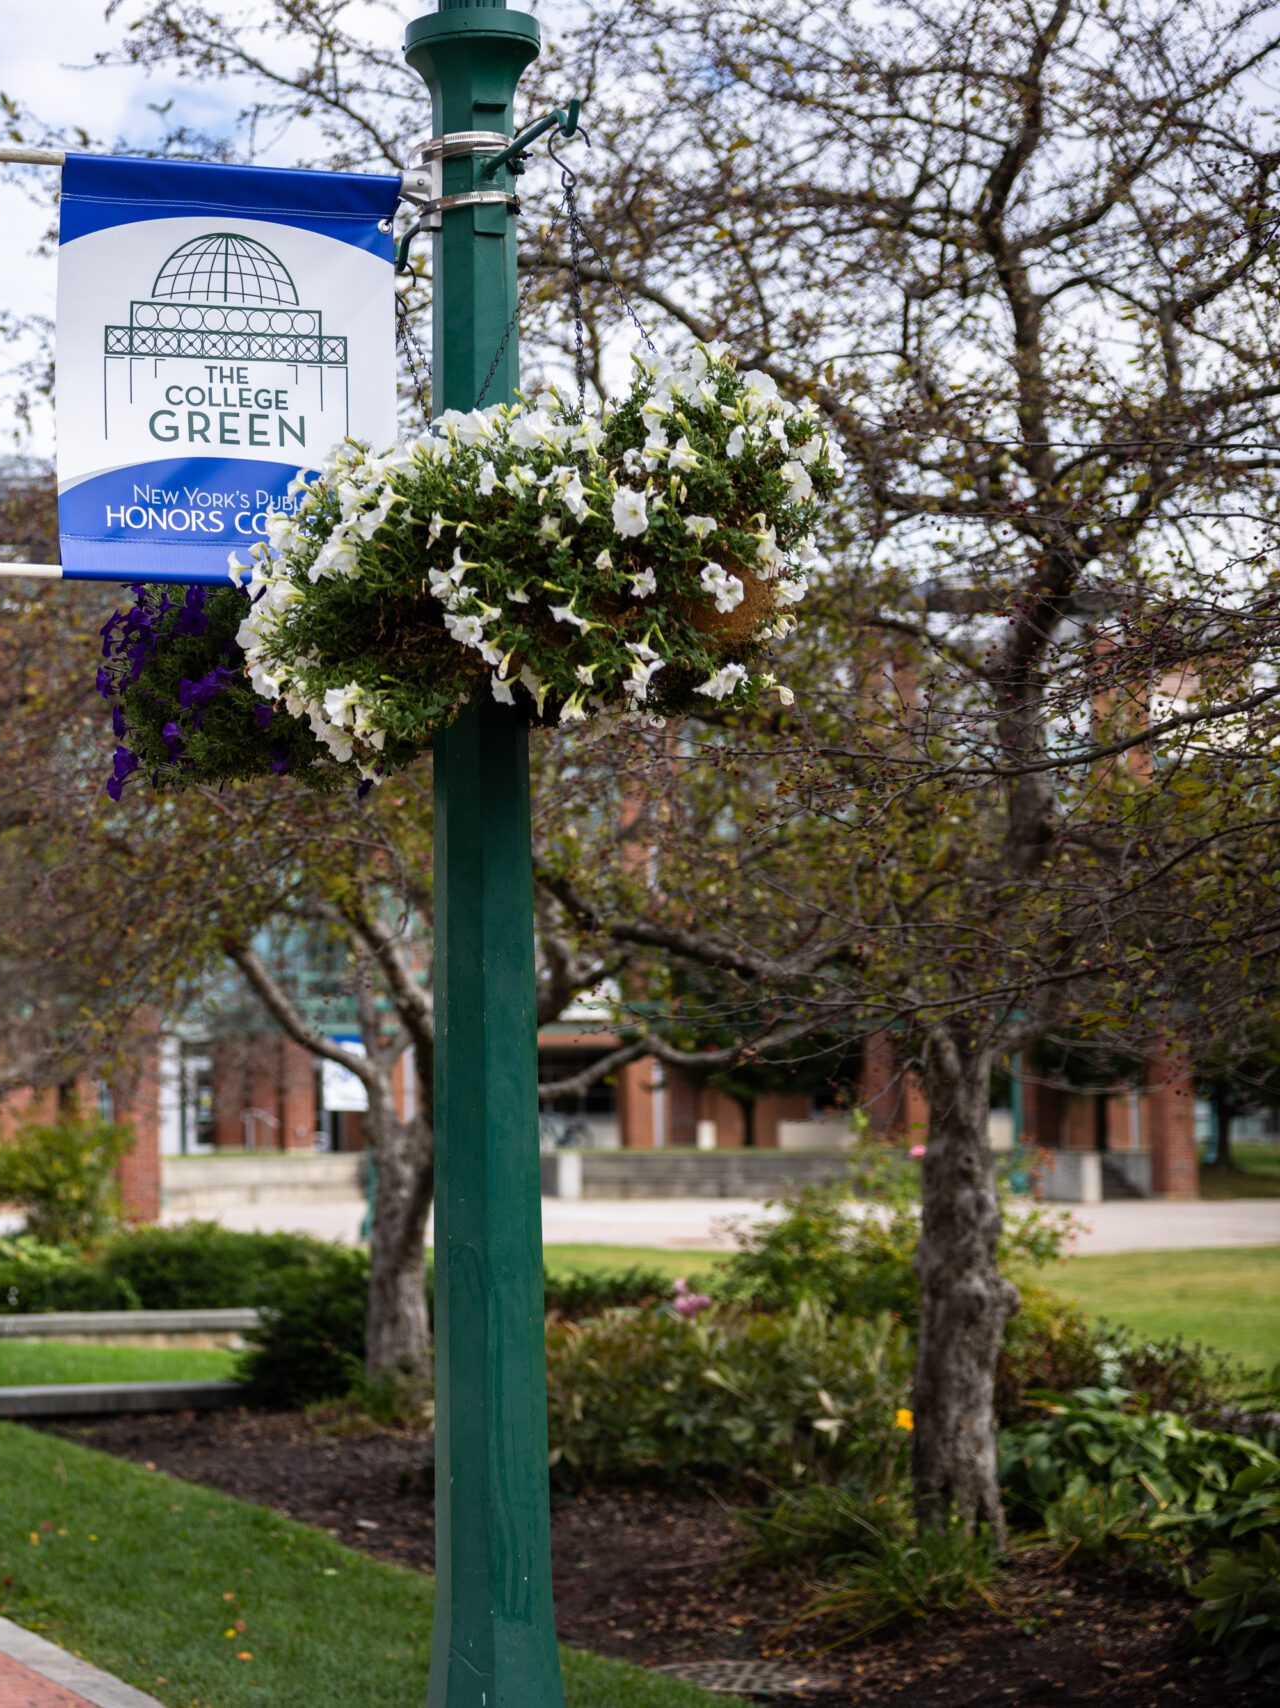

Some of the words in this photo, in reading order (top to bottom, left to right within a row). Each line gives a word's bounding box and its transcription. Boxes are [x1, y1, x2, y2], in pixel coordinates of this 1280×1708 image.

[204, 365, 249, 384] THE
[165, 385, 289, 410] COLLEGE
[148, 409, 306, 447] GREEN
[106, 505, 224, 533] HONORS
